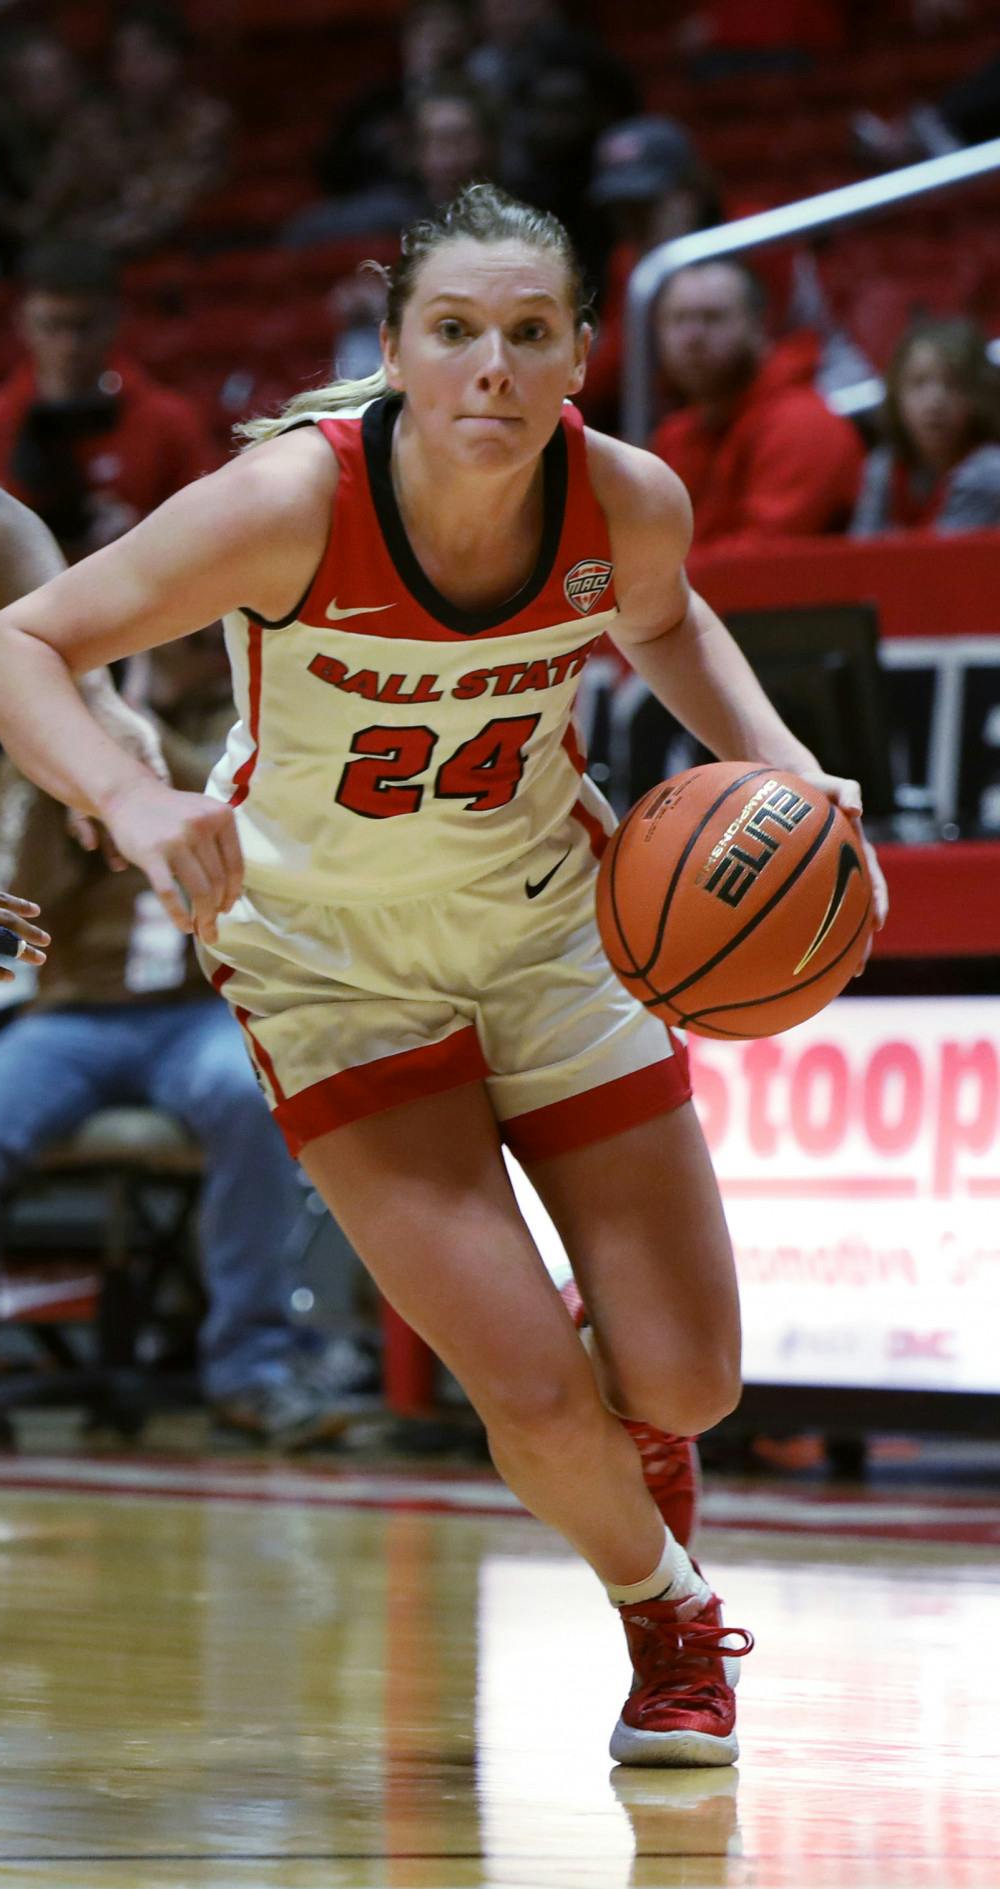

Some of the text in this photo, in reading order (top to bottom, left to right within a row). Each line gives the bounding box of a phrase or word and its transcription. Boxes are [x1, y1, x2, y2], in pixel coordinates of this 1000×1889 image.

[566, 575, 609, 594] MAC
[307, 653, 443, 704] BALL
[334, 712, 542, 820] 24
[704, 784, 815, 908] ELITE
